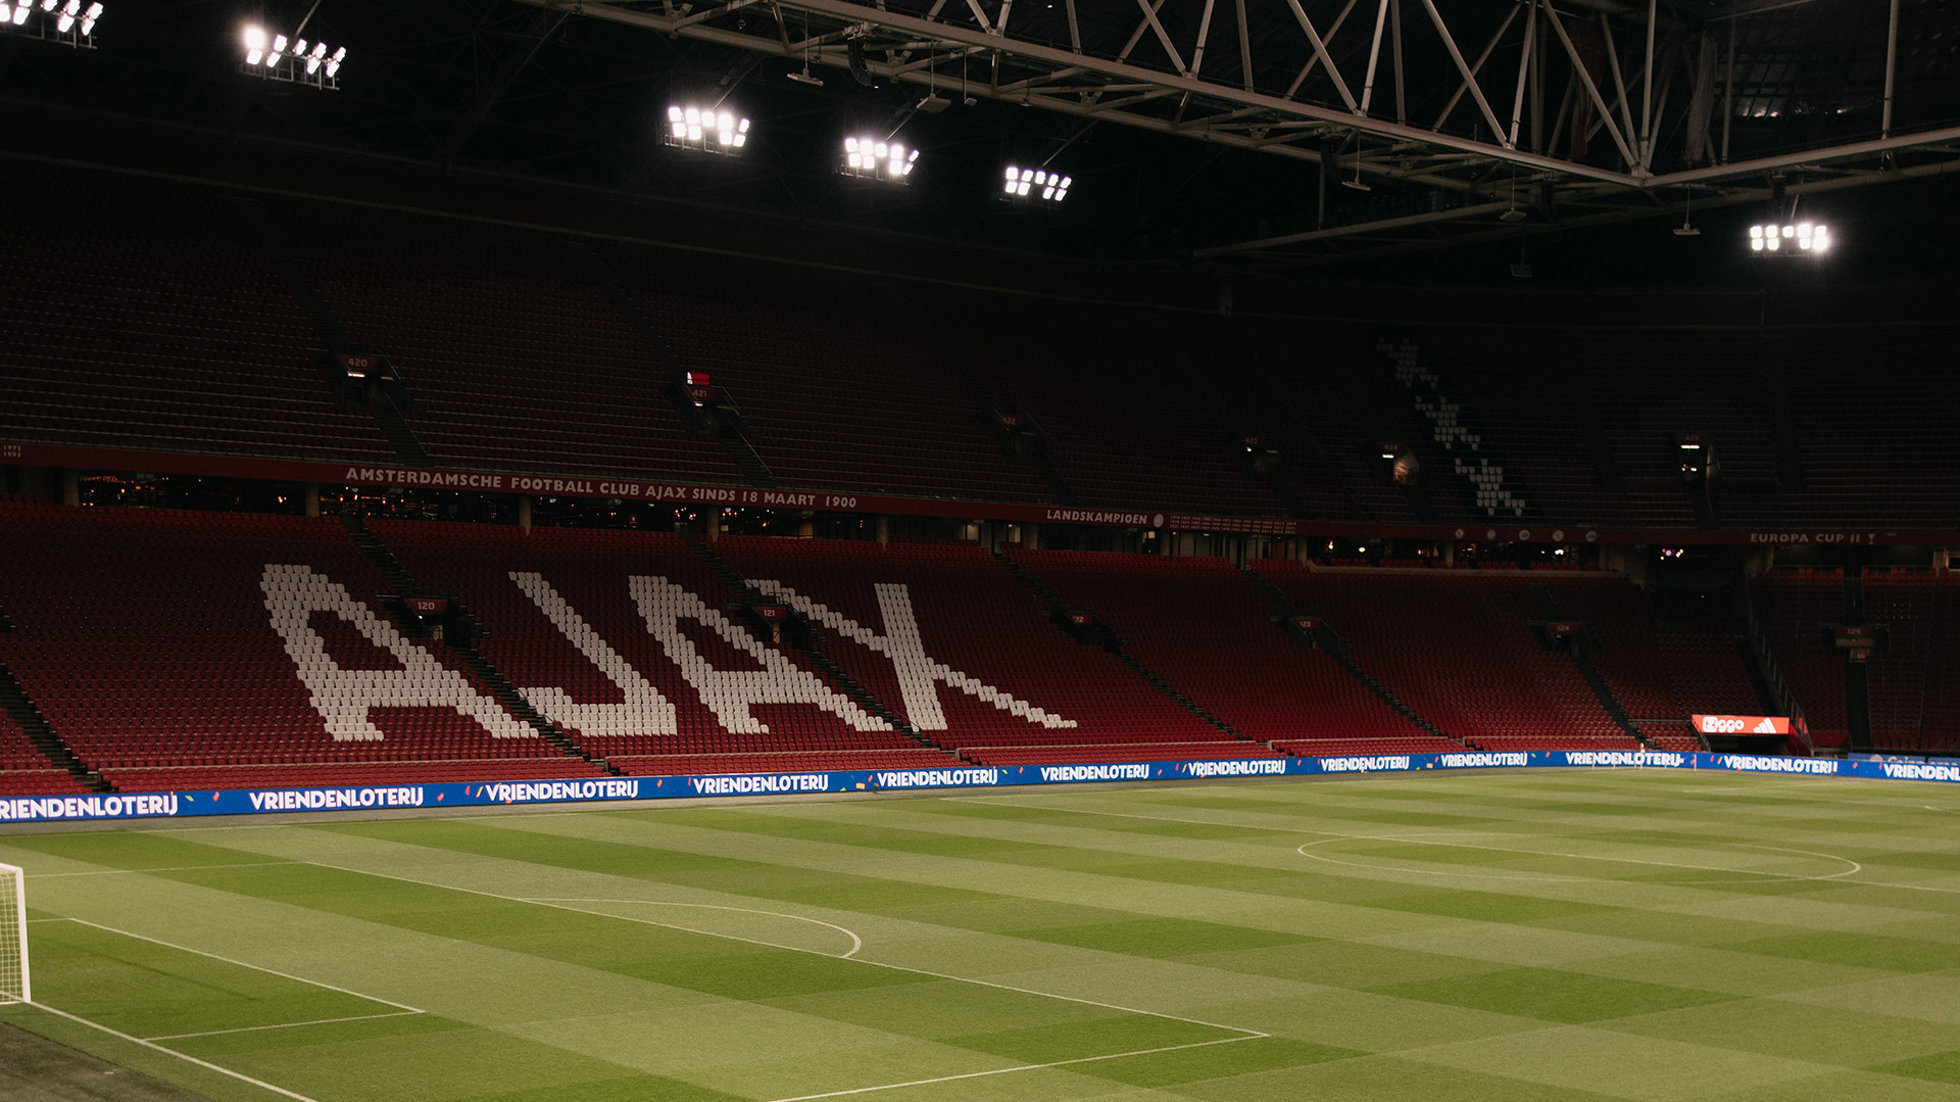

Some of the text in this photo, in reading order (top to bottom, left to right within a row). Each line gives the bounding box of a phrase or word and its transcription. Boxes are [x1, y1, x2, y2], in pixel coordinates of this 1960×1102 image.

[348, 358, 368, 367] 420
[346, 467, 857, 508] AMSTERDAMSCHE FOOTBALL CLUB AJAX SINDS 18 MAART 1900
[1046, 509, 1148, 525] LANDSKAMPIOEN
[1750, 533, 1809, 543] EUROPA
[1815, 533, 1845, 543] CUP
[417, 602, 435, 610] 120
[763, 609, 776, 617] 121
[259, 564, 1078, 742] AJAX
[1188, 760, 1286, 776] VRIENDENLOTERIJ
[1321, 756, 1410, 771] VRIENDENLOTERIJ
[1441, 753, 1528, 767] VRIENDENLOTERIJ
[877, 768, 998, 787] VRIENDENLOTERIJ
[1040, 763, 1150, 781] VRIENDENLOTERIJ
[484, 780, 639, 802] VRIENDENLOTERIJ
[693, 774, 829, 794] VRIENDENLOTERIJ
[249, 787, 424, 811] VRIENDENLOTERIJ
